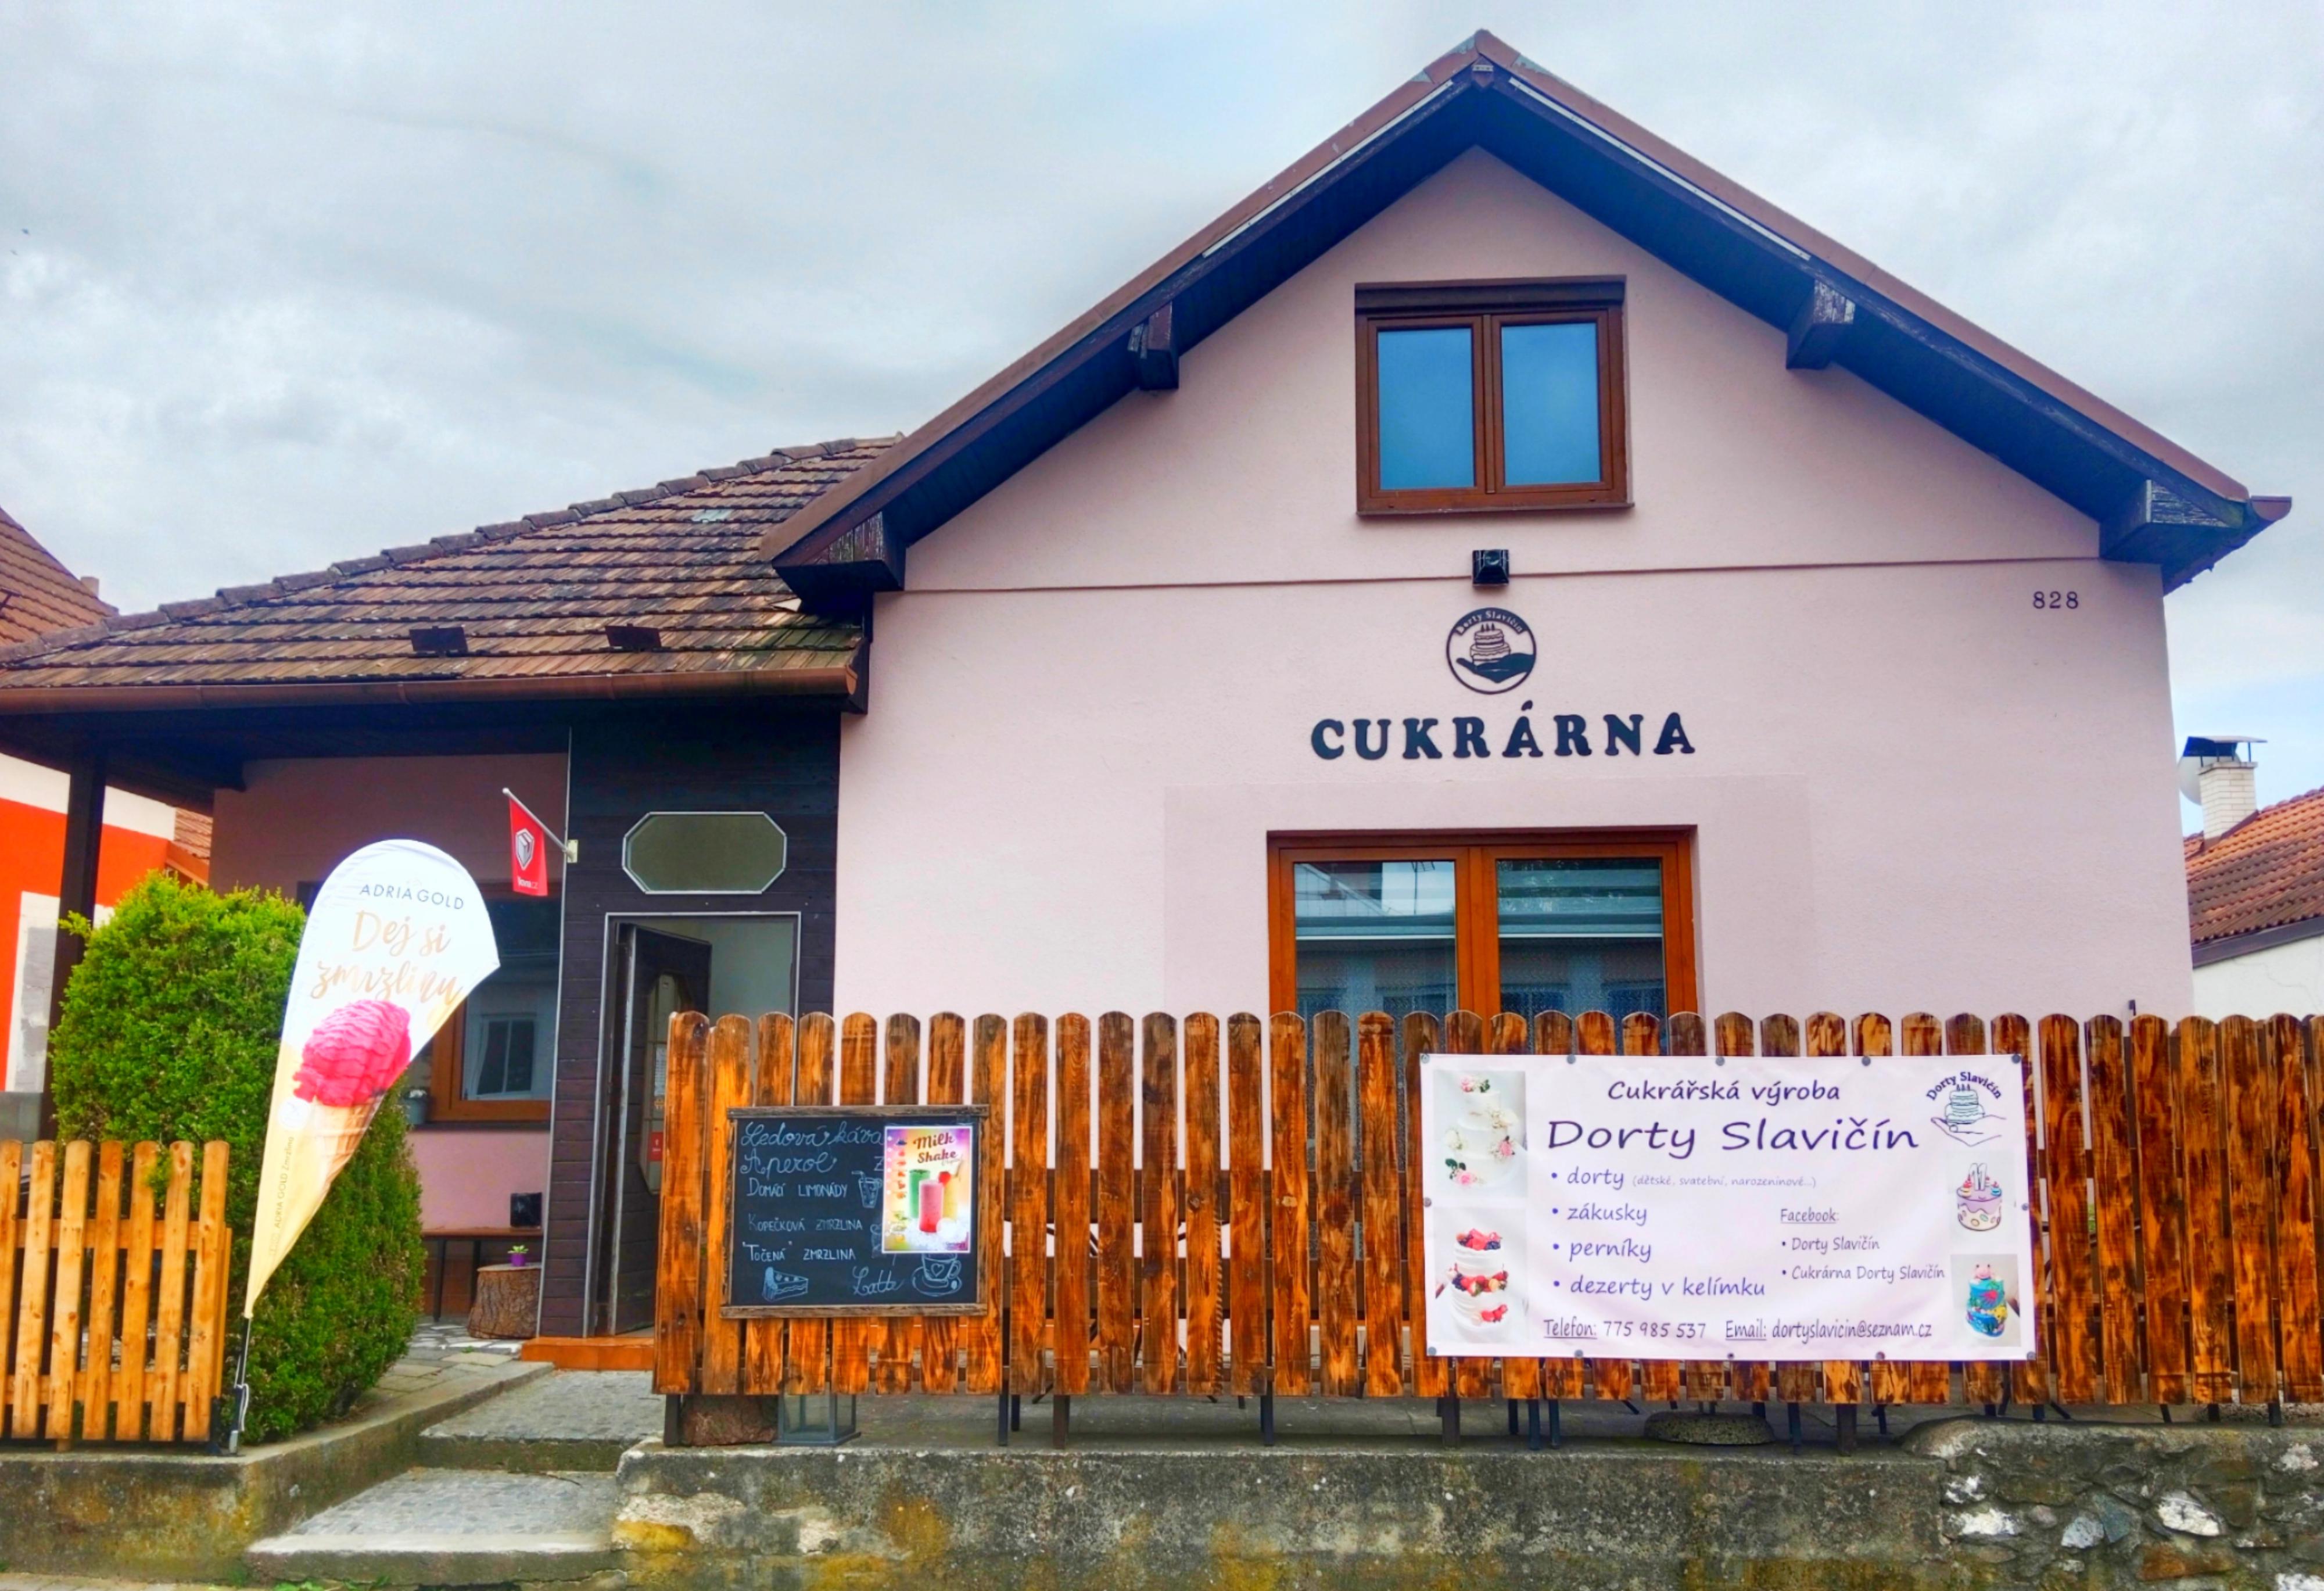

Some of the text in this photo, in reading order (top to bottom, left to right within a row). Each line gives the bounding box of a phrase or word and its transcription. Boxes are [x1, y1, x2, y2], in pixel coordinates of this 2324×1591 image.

[2033, 591, 2078, 609] 828
[1455, 614, 1482, 632] Dorty
[1311, 700, 1695, 761] CUKRÁRNA
[360, 884, 464, 909] ADRIA GOLD
[352, 910, 451, 957] Dej si
[1608, 1080, 1840, 1106] Cukrářská výroba
[1925, 1072, 2002, 1101] Dorty Slavičín
[741, 1121, 884, 1146] Ledová káva
[913, 1133, 955, 1149] Milk
[1548, 1116, 1920, 1159] Dorty Slavičín
[740, 1148, 837, 1180] Aperol
[917, 1149, 957, 1163] Shake
[277, 1173, 288, 1199] GOLD
[1566, 1166, 1624, 1190] dorty
[274, 1201, 284, 1229] ADRIA
[1567, 1203, 1648, 1227] zákusky
[803, 1248, 856, 1260] ZMRZLINA
[1569, 1238, 1652, 1263] perníky
[1791, 1235, 1880, 1255] Dorty Slavičín
[852, 1266, 902, 1297] Latte
[1792, 1264, 1945, 1284] Cukrárna Dorty Slavičín
[1570, 1275, 1765, 1301] dezerty v kelímku
[1543, 1316, 1706, 1338] Telefon: 775 985 537
[1726, 1318, 1932, 1345] Email: dortyslavicin@seznam.cz
